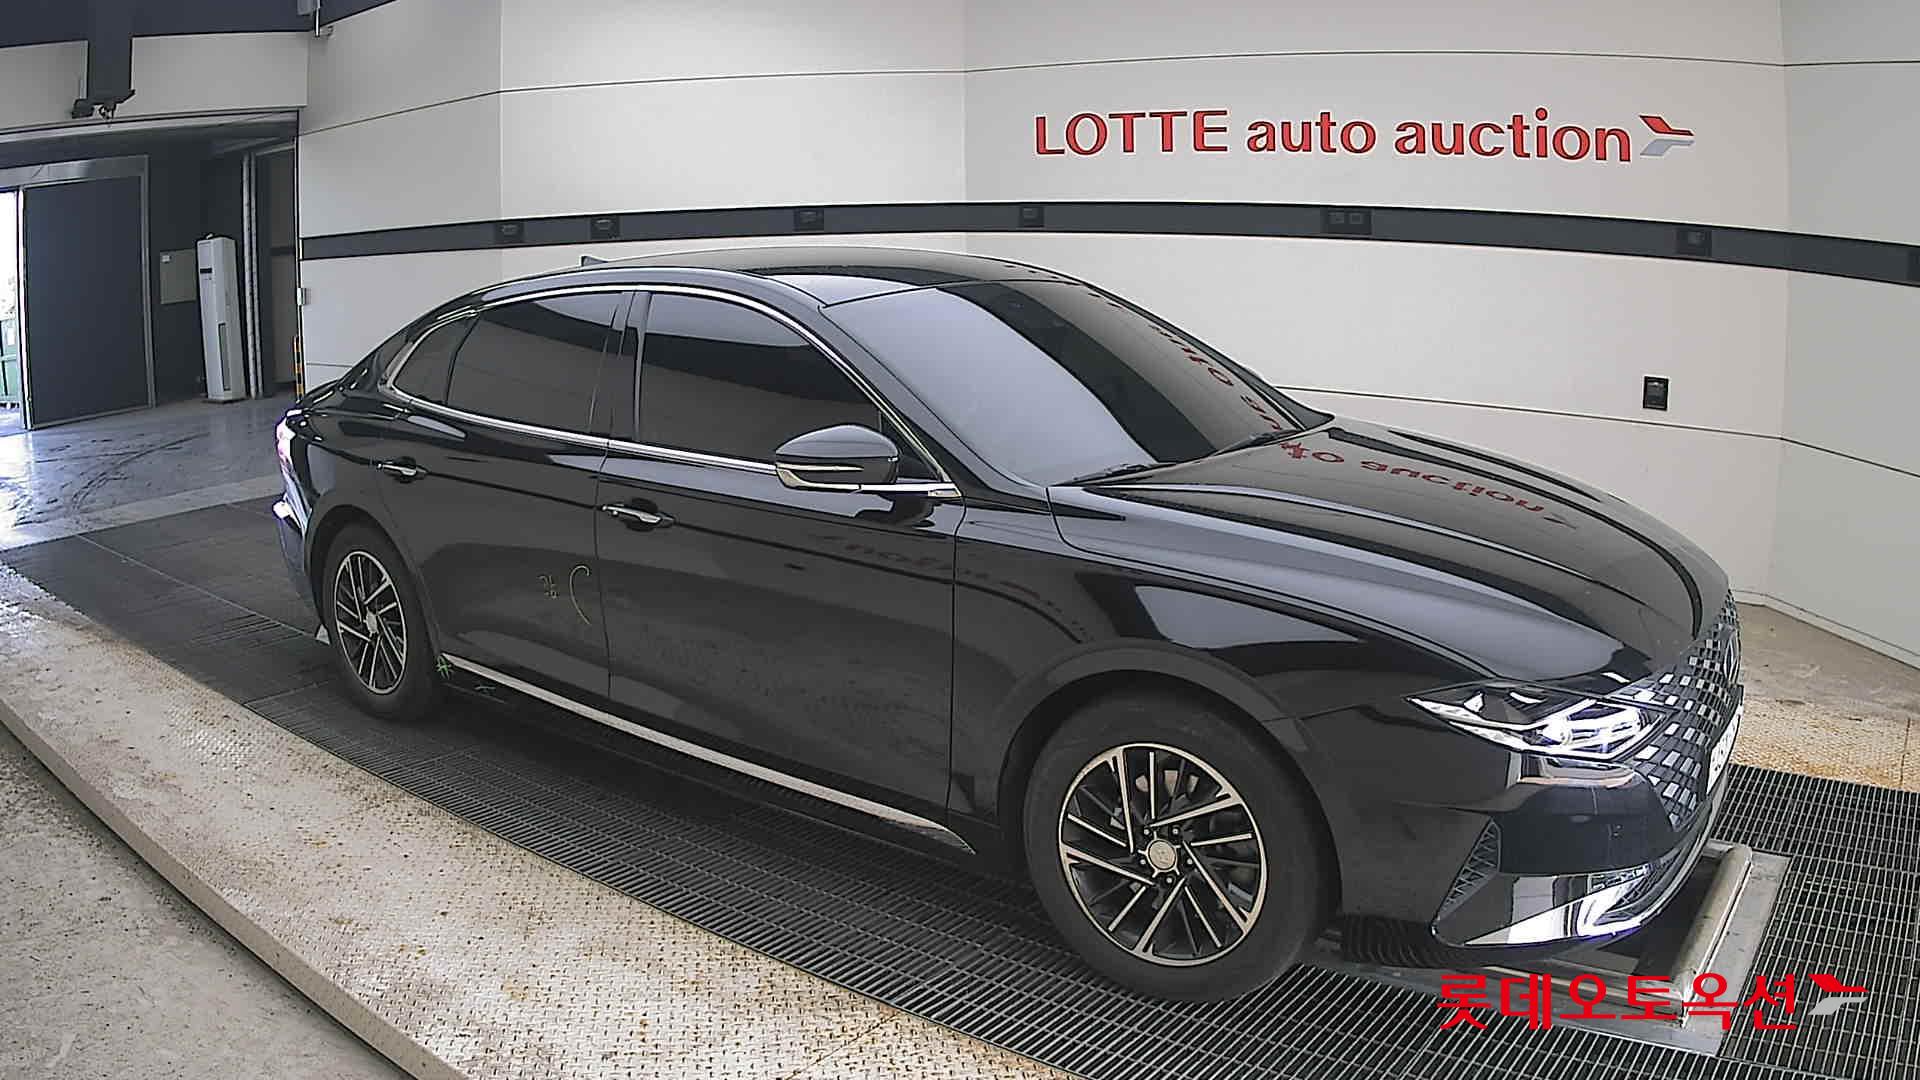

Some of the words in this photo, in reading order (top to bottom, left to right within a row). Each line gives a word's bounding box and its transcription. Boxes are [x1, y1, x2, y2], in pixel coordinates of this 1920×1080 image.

[1034, 109, 1228, 156] LOTTE
[1246, 111, 1378, 155] auto
[1394, 106, 1633, 163] auction
